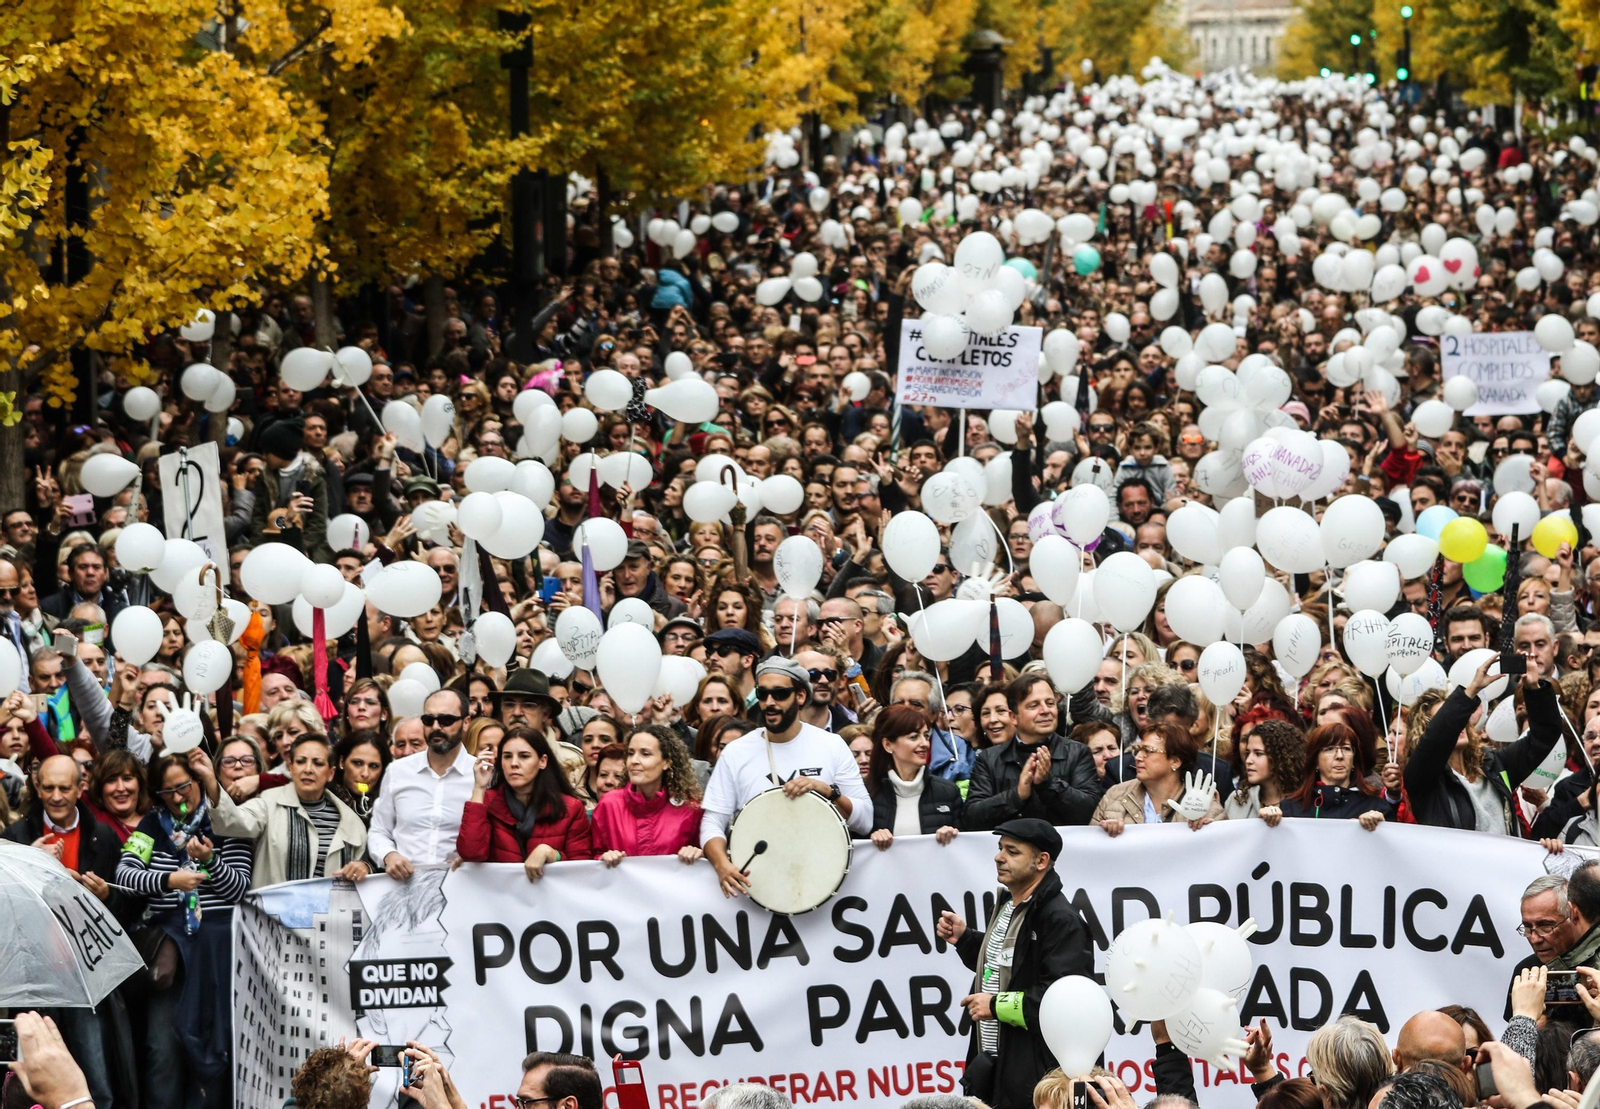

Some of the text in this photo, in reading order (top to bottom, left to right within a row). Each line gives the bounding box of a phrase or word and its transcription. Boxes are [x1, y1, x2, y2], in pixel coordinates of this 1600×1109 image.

[916, 346, 1013, 367] CLETOS
[1447, 336, 1543, 356] 2 HOSPITALES
[1457, 361, 1534, 381] COMPLETOS
[1478, 386, 1527, 404] RANADA
[570, 626, 584, 640] 2
[50, 893, 123, 972] YEAH
[472, 919, 624, 986] POR
[648, 910, 811, 978] UNA
[1188, 861, 1505, 959] PÚBLICA
[361, 962, 438, 984] QUE NO
[359, 986, 438, 1007] DIVIDAN
[524, 975, 972, 1061] DIGNA PAR
[658, 1069, 857, 1109] RECERAR
